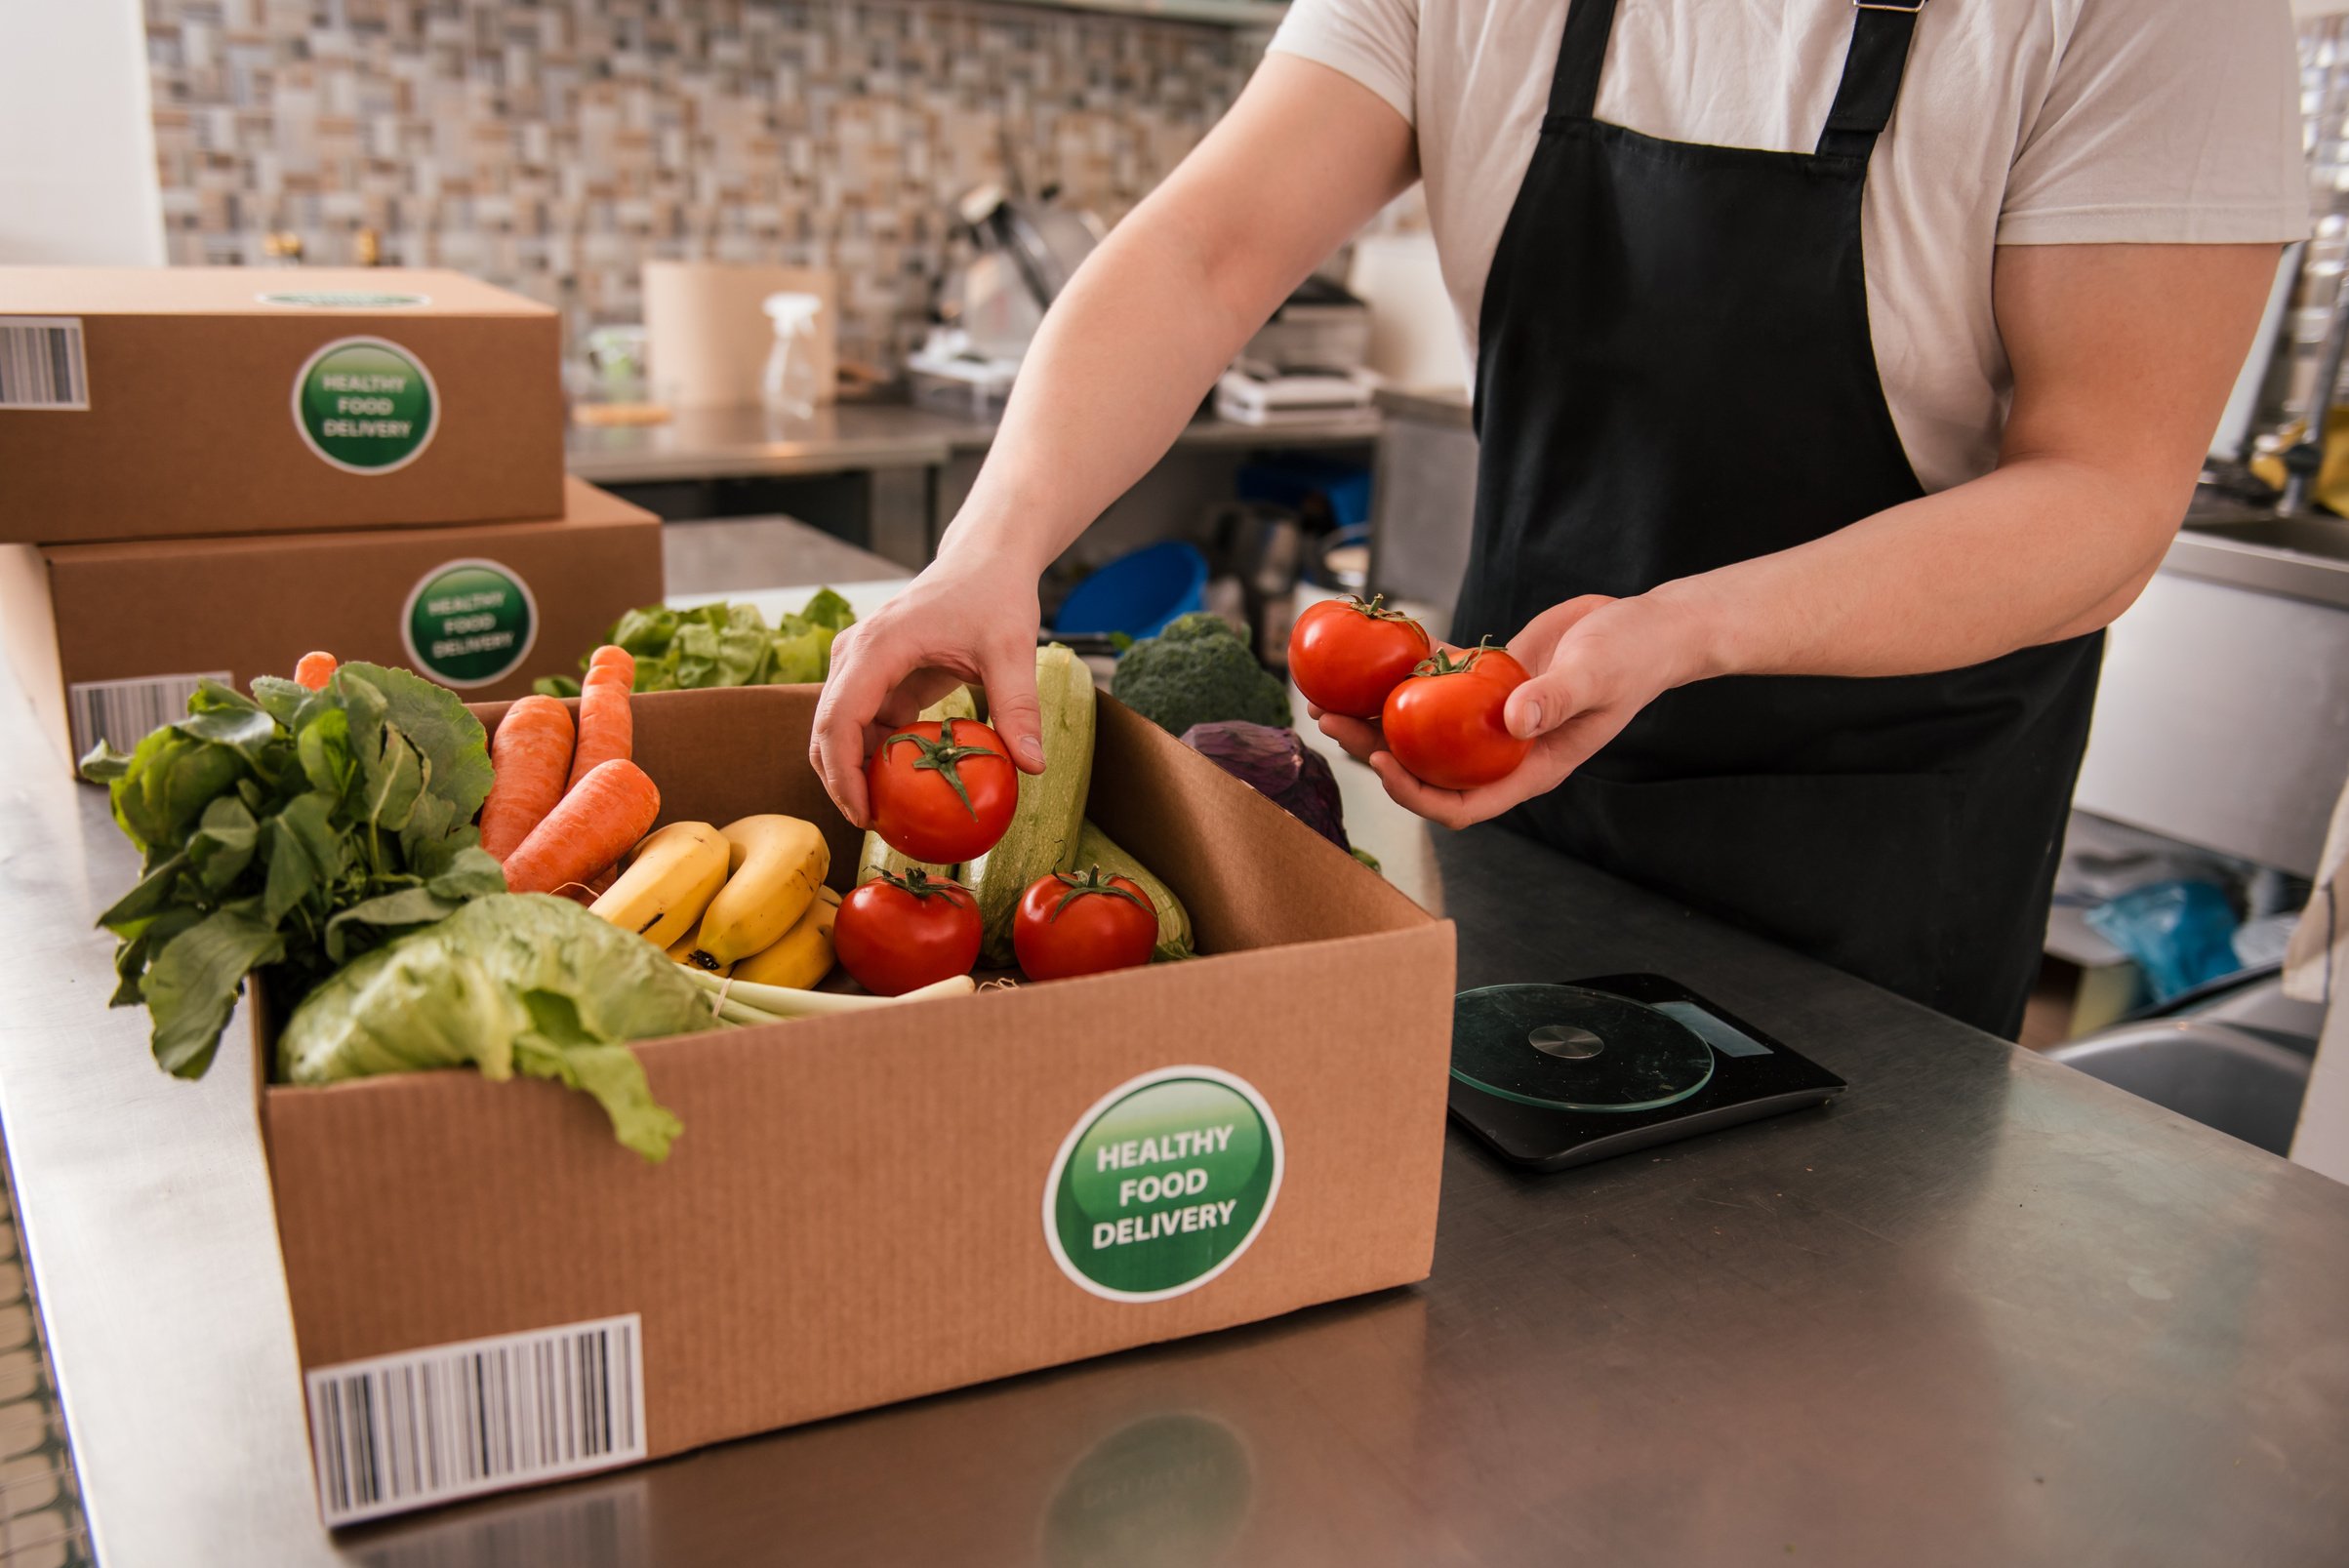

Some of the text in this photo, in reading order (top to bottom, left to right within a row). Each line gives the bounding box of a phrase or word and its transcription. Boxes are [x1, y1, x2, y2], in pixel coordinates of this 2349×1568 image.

[322, 374, 406, 393] HEALTHY
[338, 397, 394, 416] FOOD
[323, 420, 412, 438] DELIVERY
[444, 613, 497, 635] FOOD
[1097, 1124, 1234, 1172] HEALTHY
[1119, 1168, 1208, 1207] FOOD
[1092, 1199, 1236, 1250] DELIVERY
